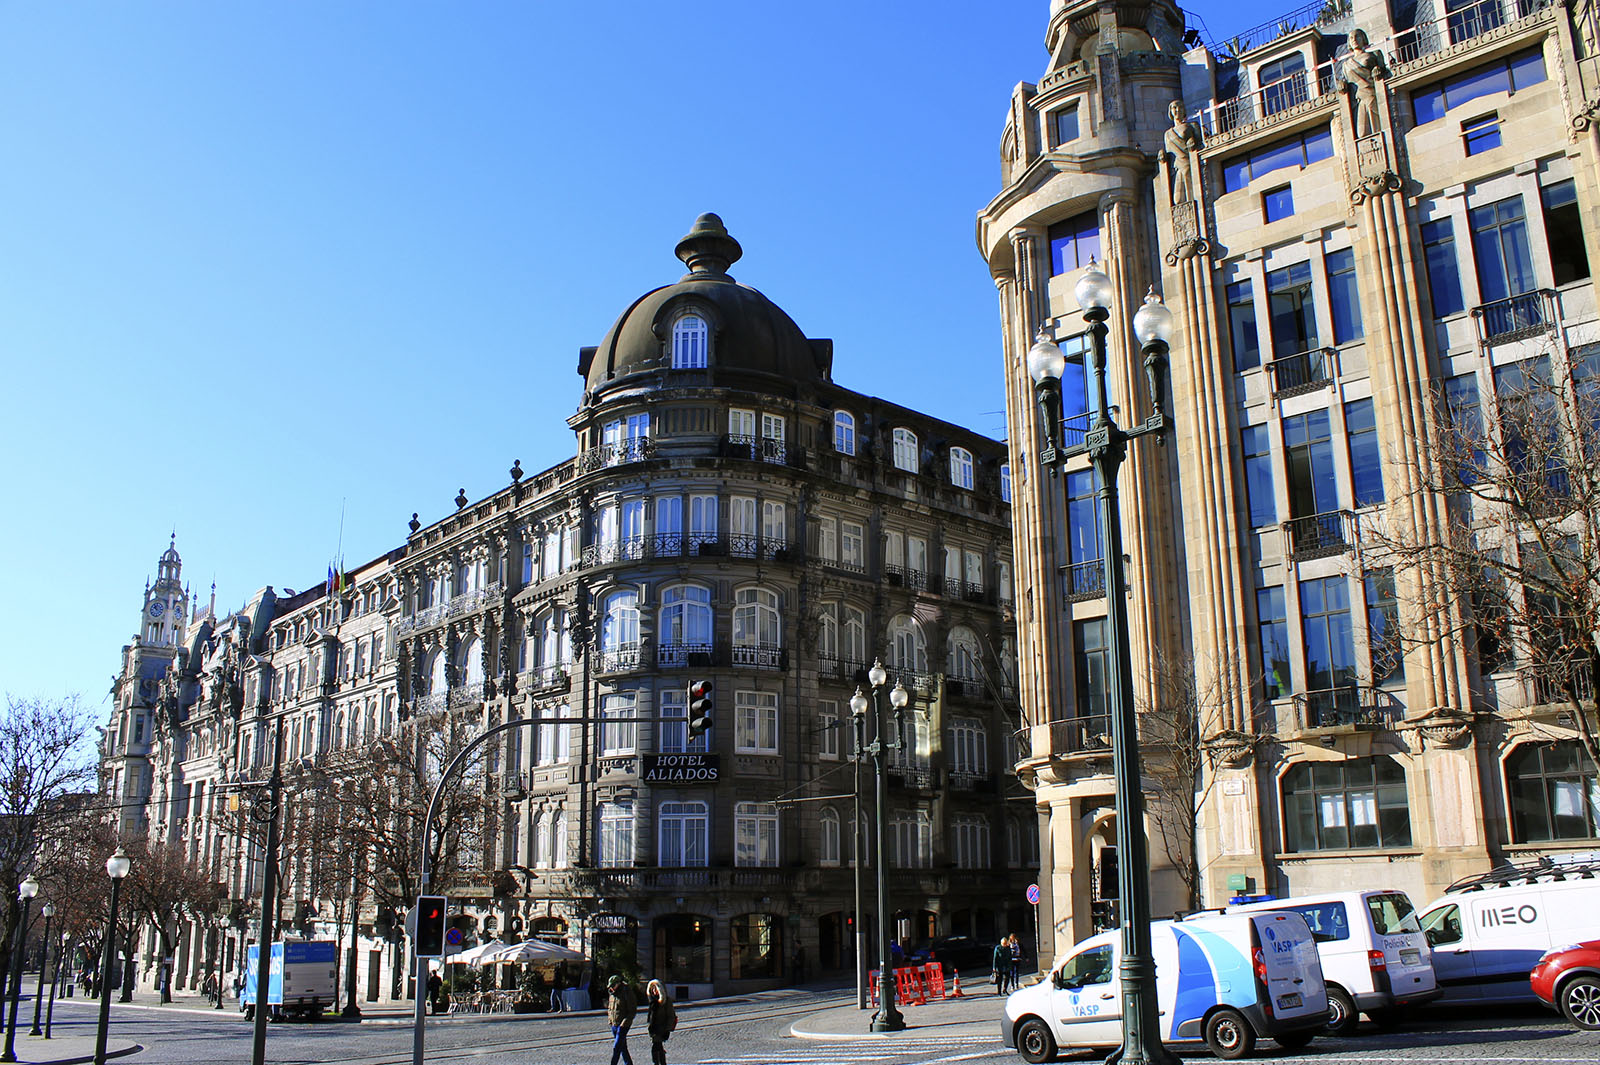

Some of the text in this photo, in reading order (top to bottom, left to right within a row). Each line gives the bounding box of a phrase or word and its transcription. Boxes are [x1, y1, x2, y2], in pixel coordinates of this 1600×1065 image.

[657, 755, 706, 766] HOTEL
[646, 768, 718, 780] ALIADOS
[1481, 904, 1537, 927] MEO
[1270, 940, 1292, 953] VASP
[1072, 1005, 1099, 1016] VASP
